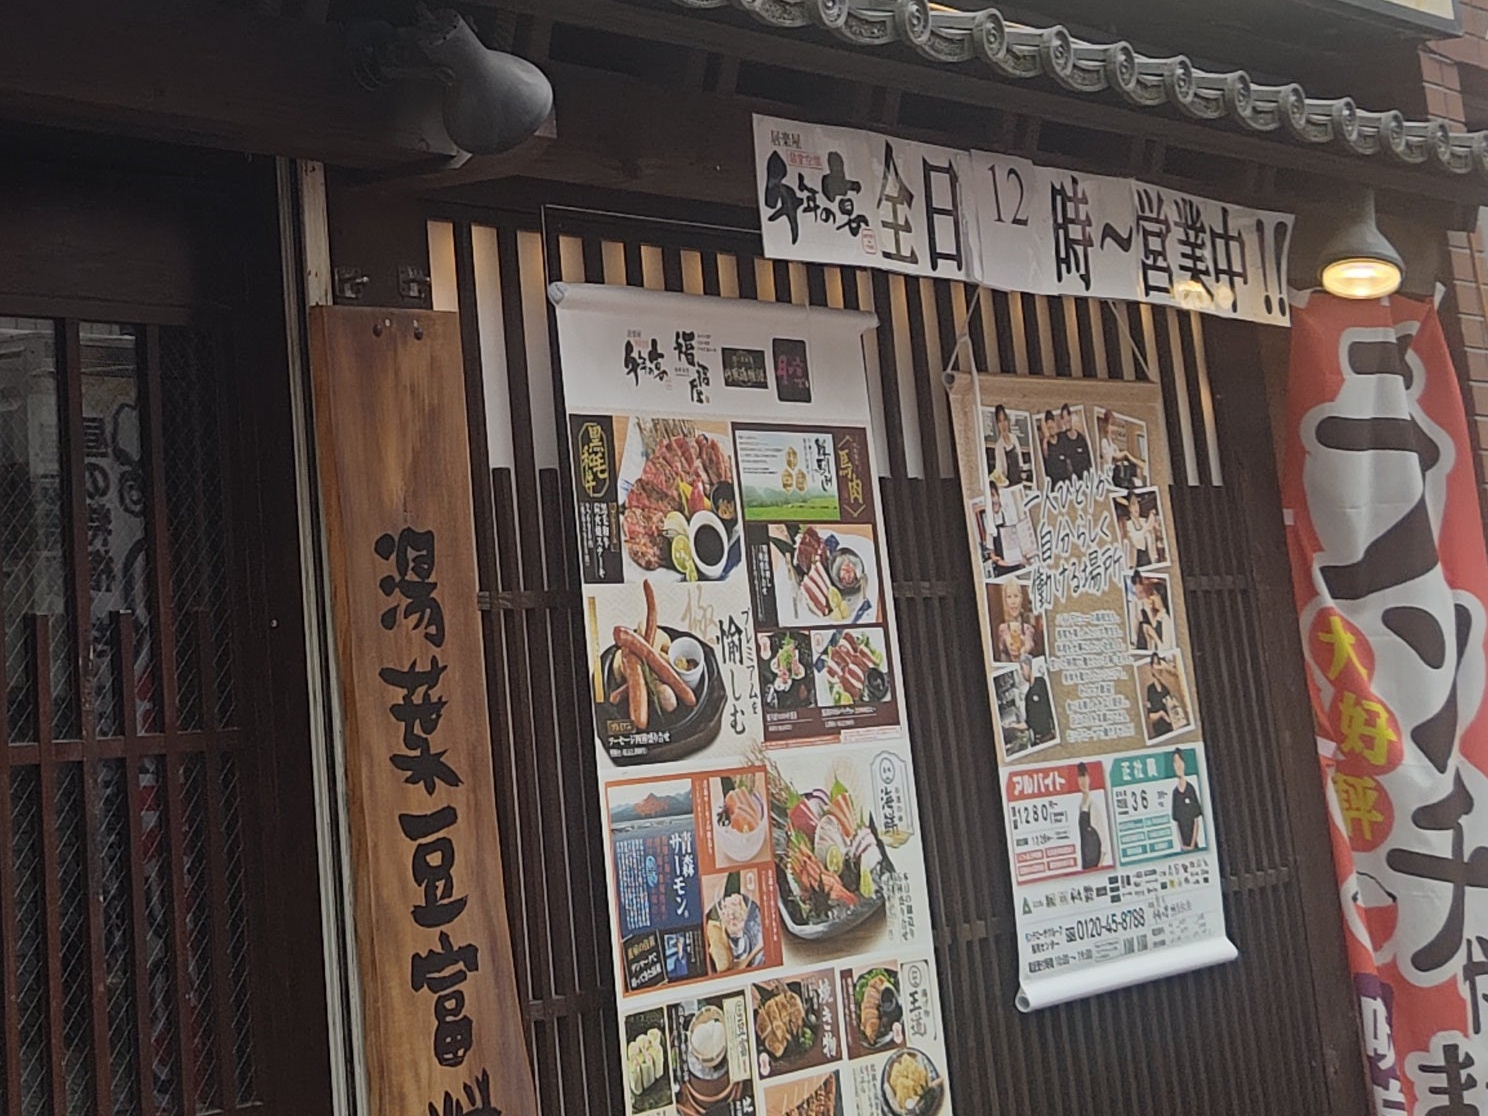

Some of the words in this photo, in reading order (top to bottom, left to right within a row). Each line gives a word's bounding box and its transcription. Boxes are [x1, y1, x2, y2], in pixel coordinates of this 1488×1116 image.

[1040, 514, 1110, 562] 自分らしく
[1012, 772, 1066, 796] アルバイト
